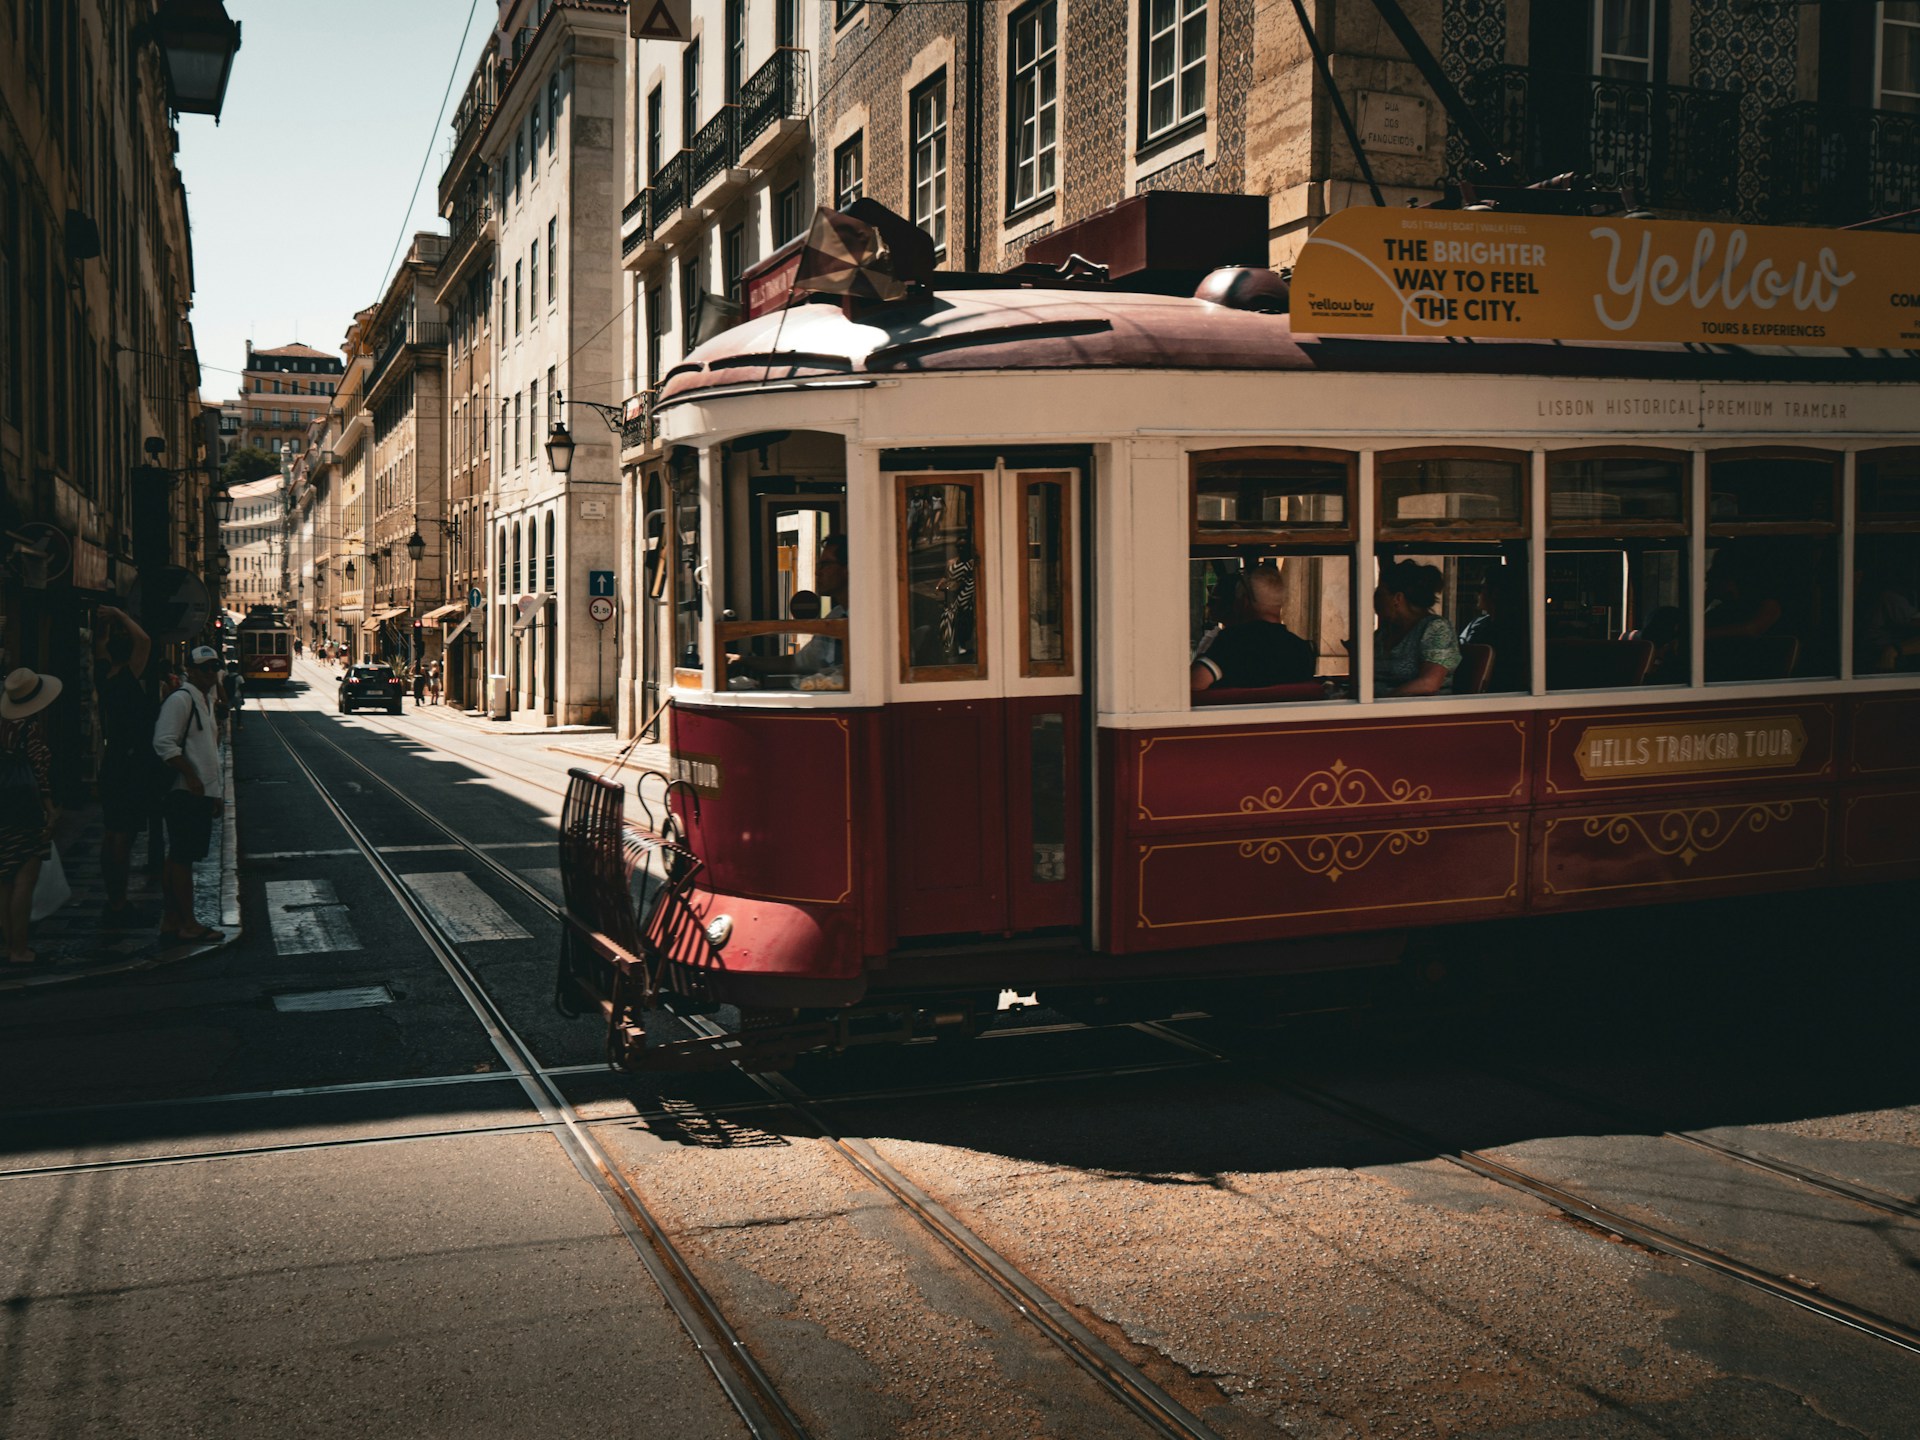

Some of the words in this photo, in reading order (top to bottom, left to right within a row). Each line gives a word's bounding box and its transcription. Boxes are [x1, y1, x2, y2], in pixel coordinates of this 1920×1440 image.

[1385, 102, 1399, 112] RUA
[1384, 118, 1399, 129] DOS
[1383, 239, 1428, 261] THE
[1433, 240, 1546, 267] BRIGHTER
[1393, 268, 1448, 291] WAY
[1453, 270, 1485, 293] TO
[1490, 271, 1540, 295] FEEL
[1353, 298, 1375, 311] bus
[1414, 297, 1459, 320] THE
[1463, 298, 1521, 322] CITY.
[1701, 322, 1740, 335] TOURS
[1741, 323, 1750, 335] &
[1752, 323, 1826, 337] EXPERIENCES
[1538, 399, 1594, 416] LISBON
[1606, 398, 1695, 415] HISTORICAL
[1707, 399, 1773, 416] PREMIUM
[1784, 402, 1847, 419] TRAMCAR
[1590, 737, 1650, 768] HILLS
[1656, 732, 1739, 763] TRAMCAR
[1744, 729, 1793, 758] TOUR
